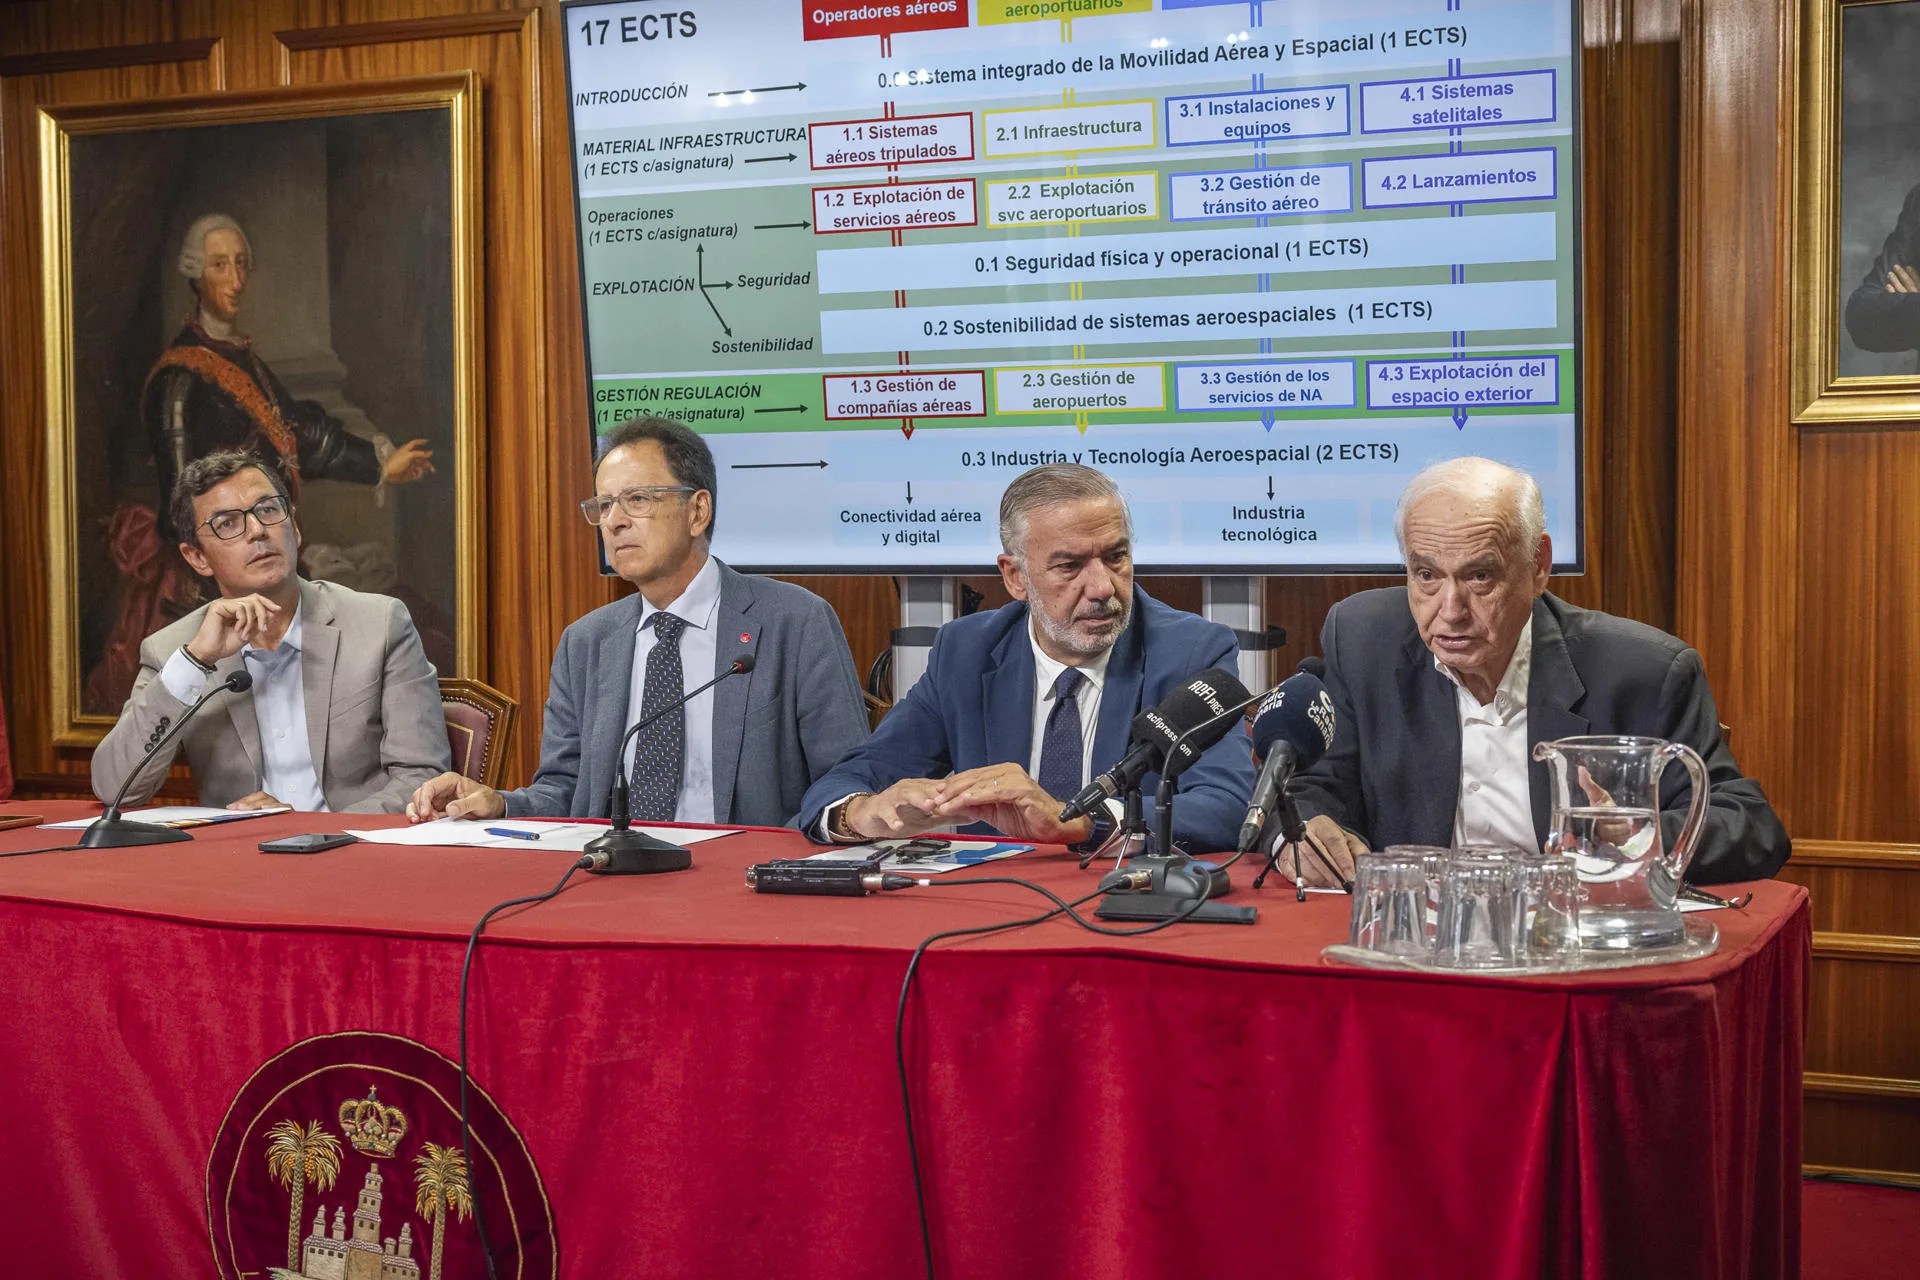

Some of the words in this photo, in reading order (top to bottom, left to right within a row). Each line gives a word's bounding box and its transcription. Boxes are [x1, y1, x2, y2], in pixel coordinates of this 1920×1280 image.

[813, 6, 900, 25] Operadores
[905, 0, 957, 17] aéreos
[580, 20, 610, 46] 17
[622, 11, 697, 43] ECTS
[909, 68, 976, 85] Sstema
[982, 59, 1068, 81] integrado
[1072, 55, 1095, 73] de
[1099, 54, 1115, 71] la
[1120, 46, 1210, 68] Movilidad
[1215, 40, 1269, 62] Aérea
[1275, 45, 1284, 62] y
[1292, 34, 1375, 58] Espacial
[1381, 31, 1398, 55] (1
[1406, 25, 1468, 47] ECTS)
[575, 83, 688, 107] INTRODUCCIÓN
[1400, 85, 1425, 102] 4.1
[1431, 80, 1514, 100] Sistemas
[1180, 101, 1203, 117] 3.1
[1208, 95, 1320, 116] Instalaciones
[1326, 95, 1335, 111] y
[1412, 104, 1503, 125] satelitales
[843, 125, 865, 142] 1.1
[869, 121, 938, 140] Sistemas
[997, 127, 1018, 141] 2.1
[1024, 120, 1142, 140] Infraestructura
[1224, 120, 1291, 141] equipos
[583, 139, 655, 156] MATERIAL
[660, 127, 807, 151] INFRAESTRUCTURA
[826, 145, 875, 163] aéreos
[881, 141, 957, 162] tripulados
[584, 164, 595, 179] (1
[601, 161, 638, 175] ECTS
[643, 154, 734, 174] c/asignatura)
[1008, 185, 1031, 200] 2.2
[1040, 179, 1134, 200] Explotación
[1200, 176, 1224, 192] 3.2
[1229, 170, 1295, 191] Gestión
[1300, 170, 1321, 186] de
[1381, 174, 1407, 191] 4.2
[1413, 168, 1537, 188] Lanzamientos
[823, 192, 844, 207] 1.2
[853, 186, 942, 206] Explotación
[947, 185, 965, 200] de
[1203, 193, 1266, 215] tránsito
[1271, 194, 1319, 211] aéreo
[588, 208, 674, 225] Operaciones
[833, 211, 899, 228] servicios
[904, 208, 956, 224] aéreos
[998, 210, 1024, 222] svc
[1030, 201, 1147, 221] aeroportuarios
[589, 231, 600, 246] (1
[606, 228, 643, 243] ECTS
[648, 223, 738, 241] c/asignatura)
[975, 257, 1000, 274] 0.1
[1006, 251, 1095, 272] Seguridad
[1100, 248, 1149, 267] física
[1154, 251, 1164, 268] y
[1171, 242, 1279, 266] operacional
[1285, 241, 1302, 262] (1
[1309, 237, 1370, 258] ECTS)
[593, 277, 694, 296] EXPLOTACIÓN
[737, 272, 810, 290] Seguridad
[924, 320, 948, 337] 0.2
[955, 313, 1077, 338] Sostenibilidad
[1083, 313, 1105, 330] de
[1110, 310, 1190, 329] sistemas
[1196, 305, 1336, 327] aeroespaciales
[1348, 302, 1365, 323] (1
[1371, 300, 1433, 321] ECTS)
[711, 337, 814, 354] Sostenibilidad
[1023, 373, 1045, 387] 2.3
[1050, 371, 1111, 386] Gestión
[1116, 371, 1135, 384] de
[1200, 370, 1222, 385] 3.3
[1225, 369, 1282, 384] Gestión
[1287, 370, 1304, 383] de
[1307, 368, 1330, 382] los
[1379, 365, 1404, 381] 4.3
[1409, 361, 1514, 383] Explotación
[1519, 361, 1546, 378] del
[596, 386, 659, 402] GESTIÓN
[664, 383, 761, 400] REGULACIÓN
[850, 378, 872, 394] 1.3
[876, 376, 934, 393] Gestión
[939, 377, 957, 392] de
[1208, 388, 1274, 404] servicios
[1279, 389, 1296, 402] de
[1300, 387, 1322, 402] NA
[838, 398, 918, 417] compañías
[922, 397, 972, 413] aéreas
[1033, 394, 1127, 410] aeropuertos
[1392, 387, 1460, 407] espacio
[1464, 386, 1533, 402] exterior
[597, 409, 608, 424] (1
[962, 451, 986, 467] 0.3
[991, 449, 1067, 467] Industria
[1089, 446, 1185, 467] Tecnología
[1190, 445, 1310, 466] Aeroespacial
[1316, 443, 1333, 464] (2
[1339, 442, 1400, 462] ECTS)
[840, 509, 936, 523] Conectividad
[941, 509, 981, 522] aérea
[1233, 505, 1305, 520] Industria
[882, 533, 890, 546] y
[895, 530, 940, 546] digital
[1222, 525, 1317, 544] tecnológica
[1188, 680, 1216, 702] ACFI
[1207, 698, 1225, 716] PRES
[1146, 712, 1192, 756] acfipressom
